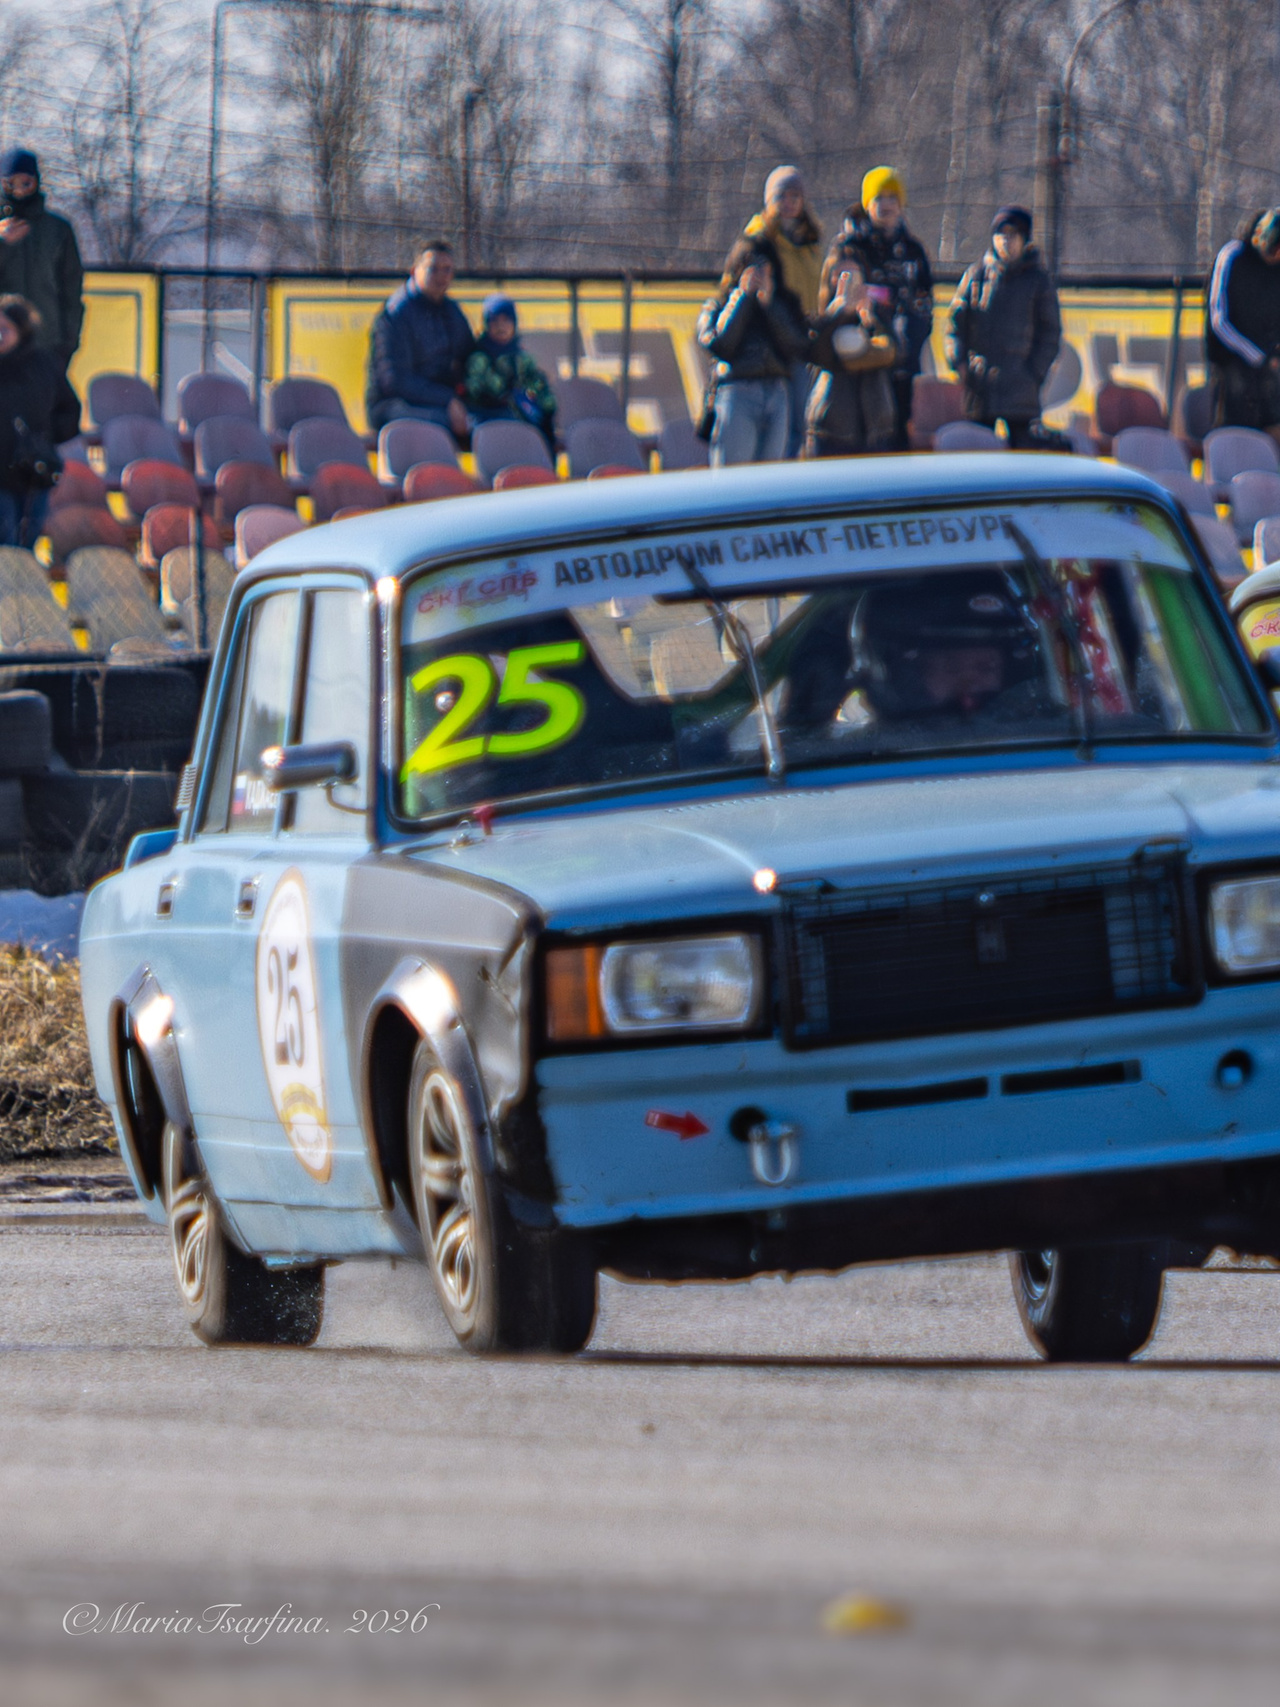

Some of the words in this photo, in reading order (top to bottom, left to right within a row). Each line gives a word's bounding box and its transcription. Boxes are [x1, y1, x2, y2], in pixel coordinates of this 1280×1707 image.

[479, 570, 539, 595] СПБ
[554, 539, 725, 587] АВТОДРОМ
[730, 513, 1013, 564] САНКТ-ПЕТЕРБУРГ
[400, 639, 582, 784] 25
[267, 943, 306, 1068] 25
